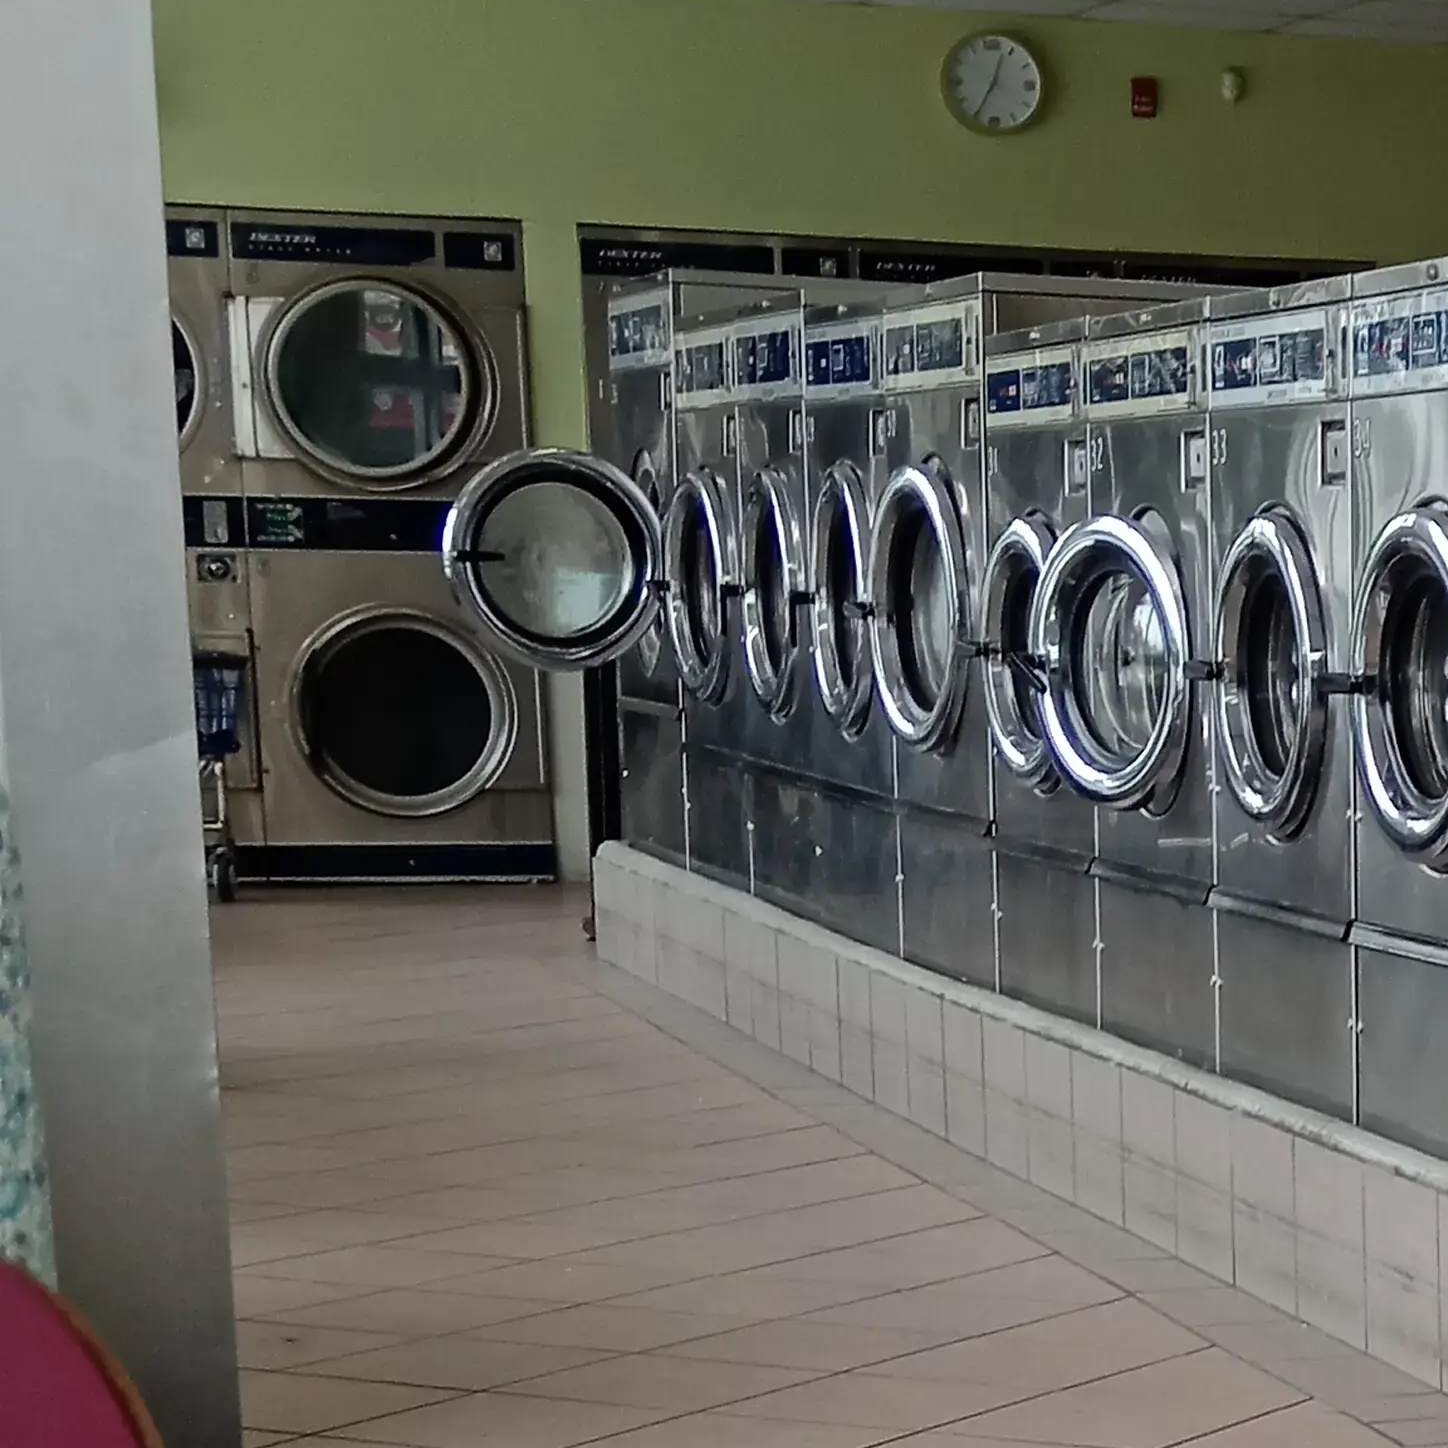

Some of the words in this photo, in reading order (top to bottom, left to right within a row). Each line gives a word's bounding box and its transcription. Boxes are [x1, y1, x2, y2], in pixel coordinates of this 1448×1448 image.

[1091, 437, 1103, 472] 32
[1212, 428, 1227, 466] 33
[1353, 417, 1371, 458] 34
